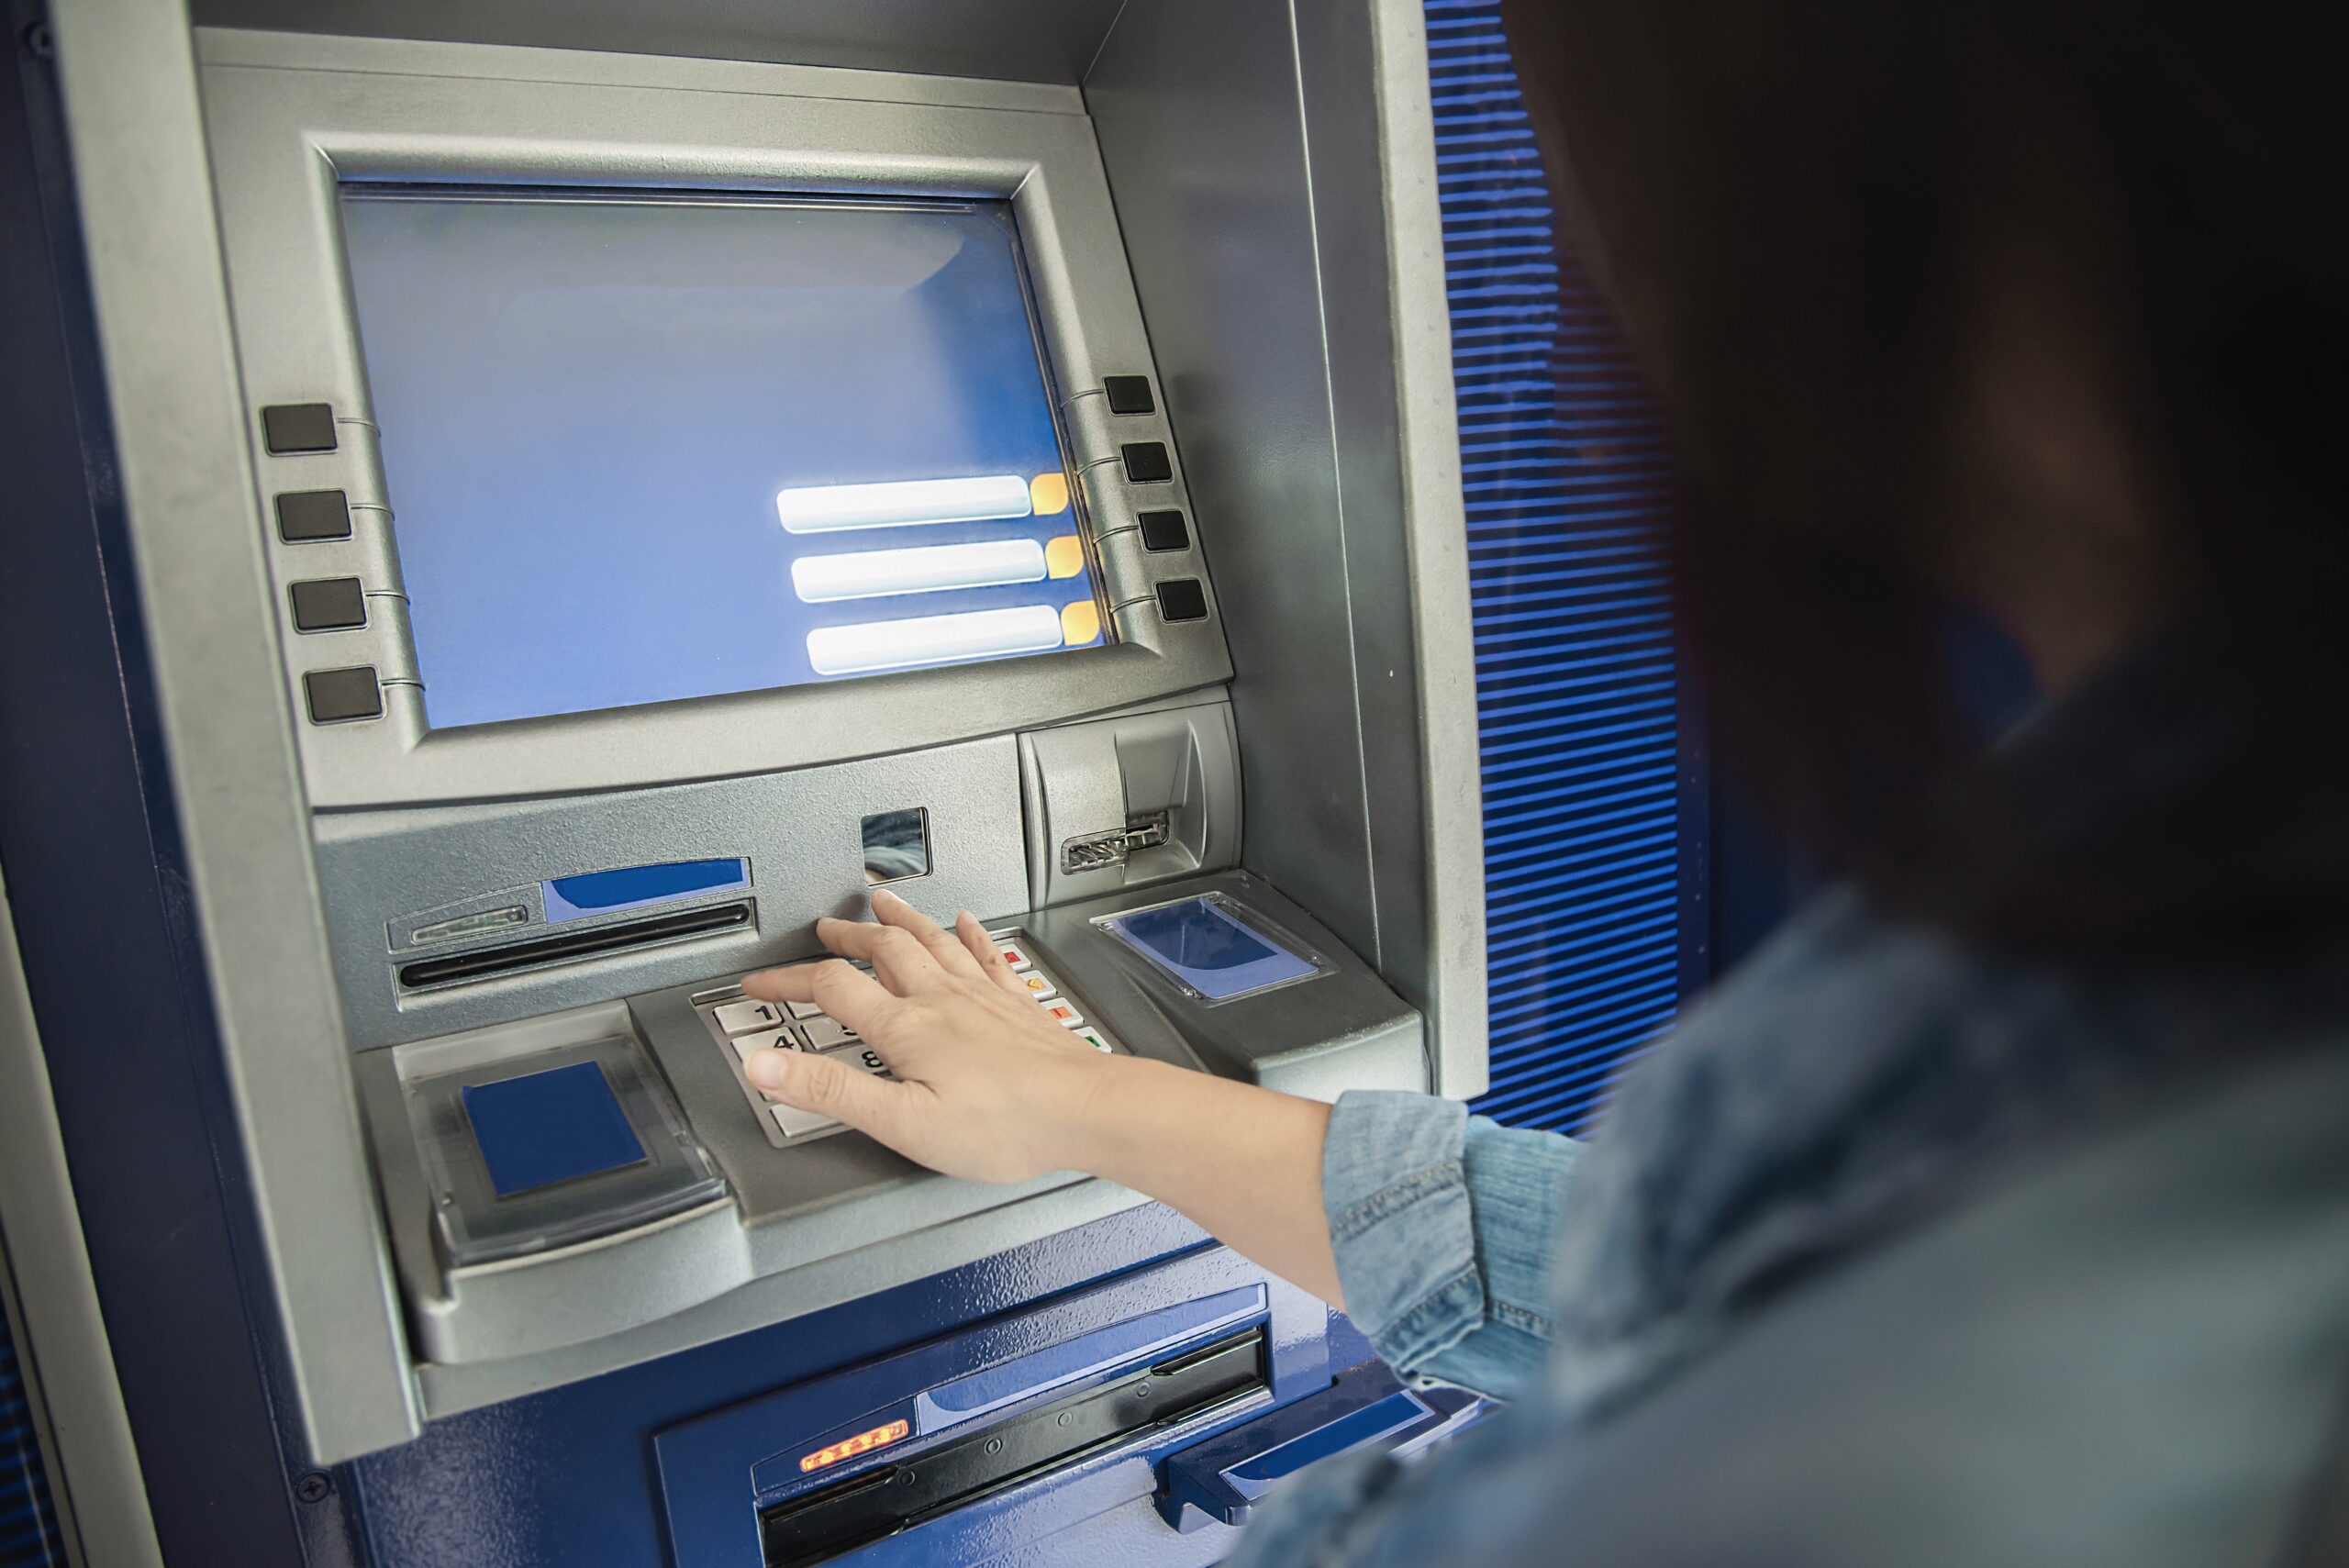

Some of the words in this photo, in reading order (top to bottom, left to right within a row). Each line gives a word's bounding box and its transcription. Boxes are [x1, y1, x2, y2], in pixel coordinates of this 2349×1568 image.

[755, 1006, 773, 1020] 1
[774, 1035, 794, 1050] 4
[862, 1051, 884, 1068] 8
